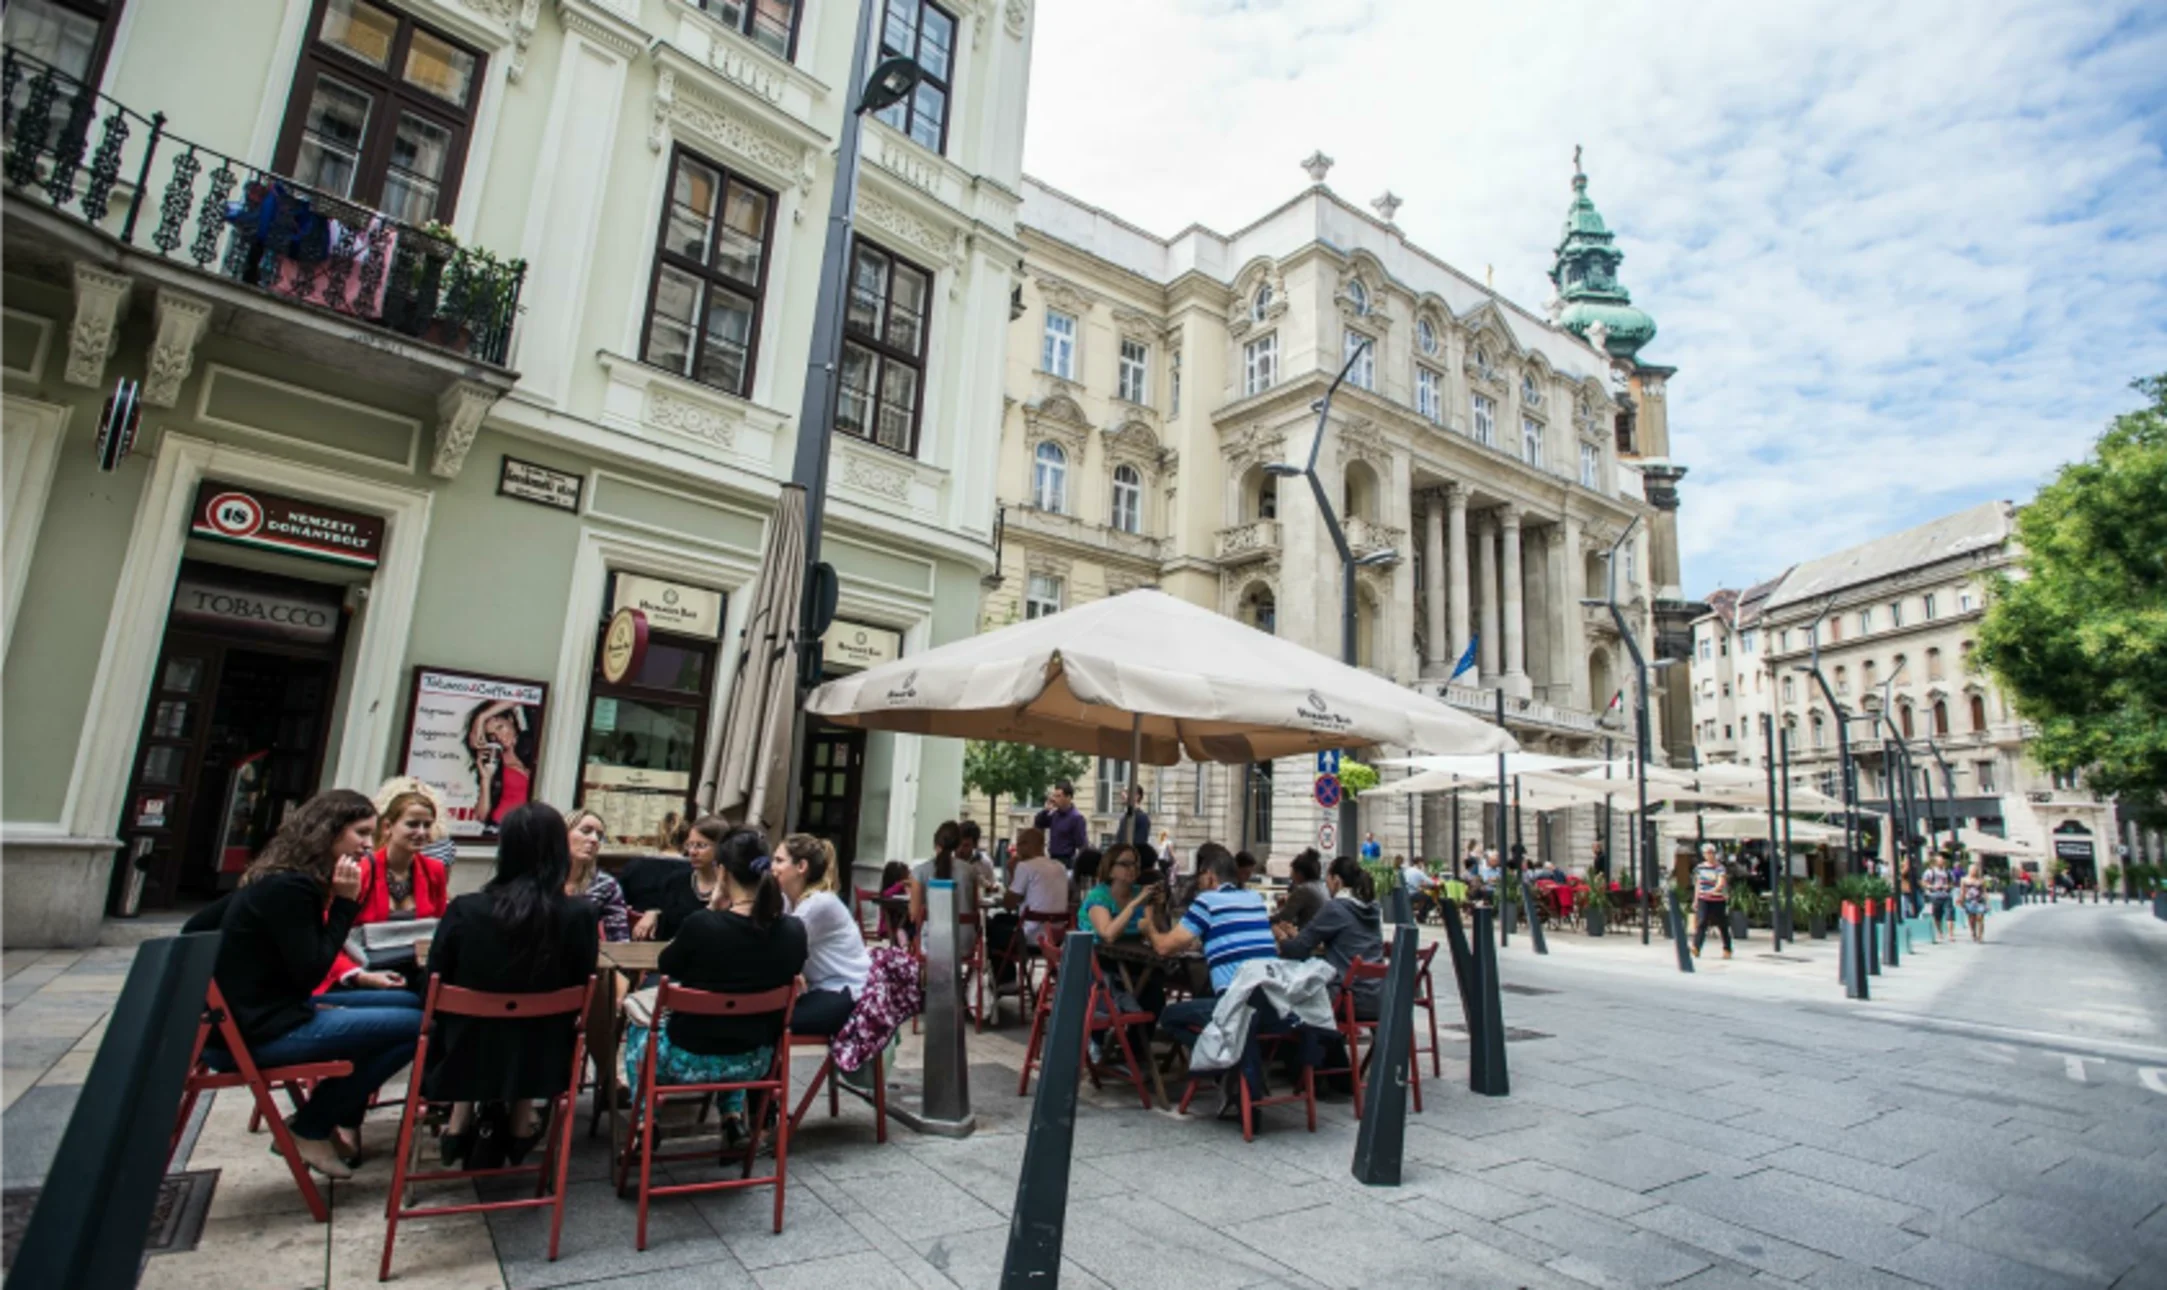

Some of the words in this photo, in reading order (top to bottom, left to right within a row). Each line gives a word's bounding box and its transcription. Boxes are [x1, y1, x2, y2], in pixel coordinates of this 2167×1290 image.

[222, 507, 249, 525] 18
[287, 511, 357, 533] NEMZETI
[267, 520, 370, 547] DOHÁNYBOLT
[192, 590, 327, 628] TOBACCO
